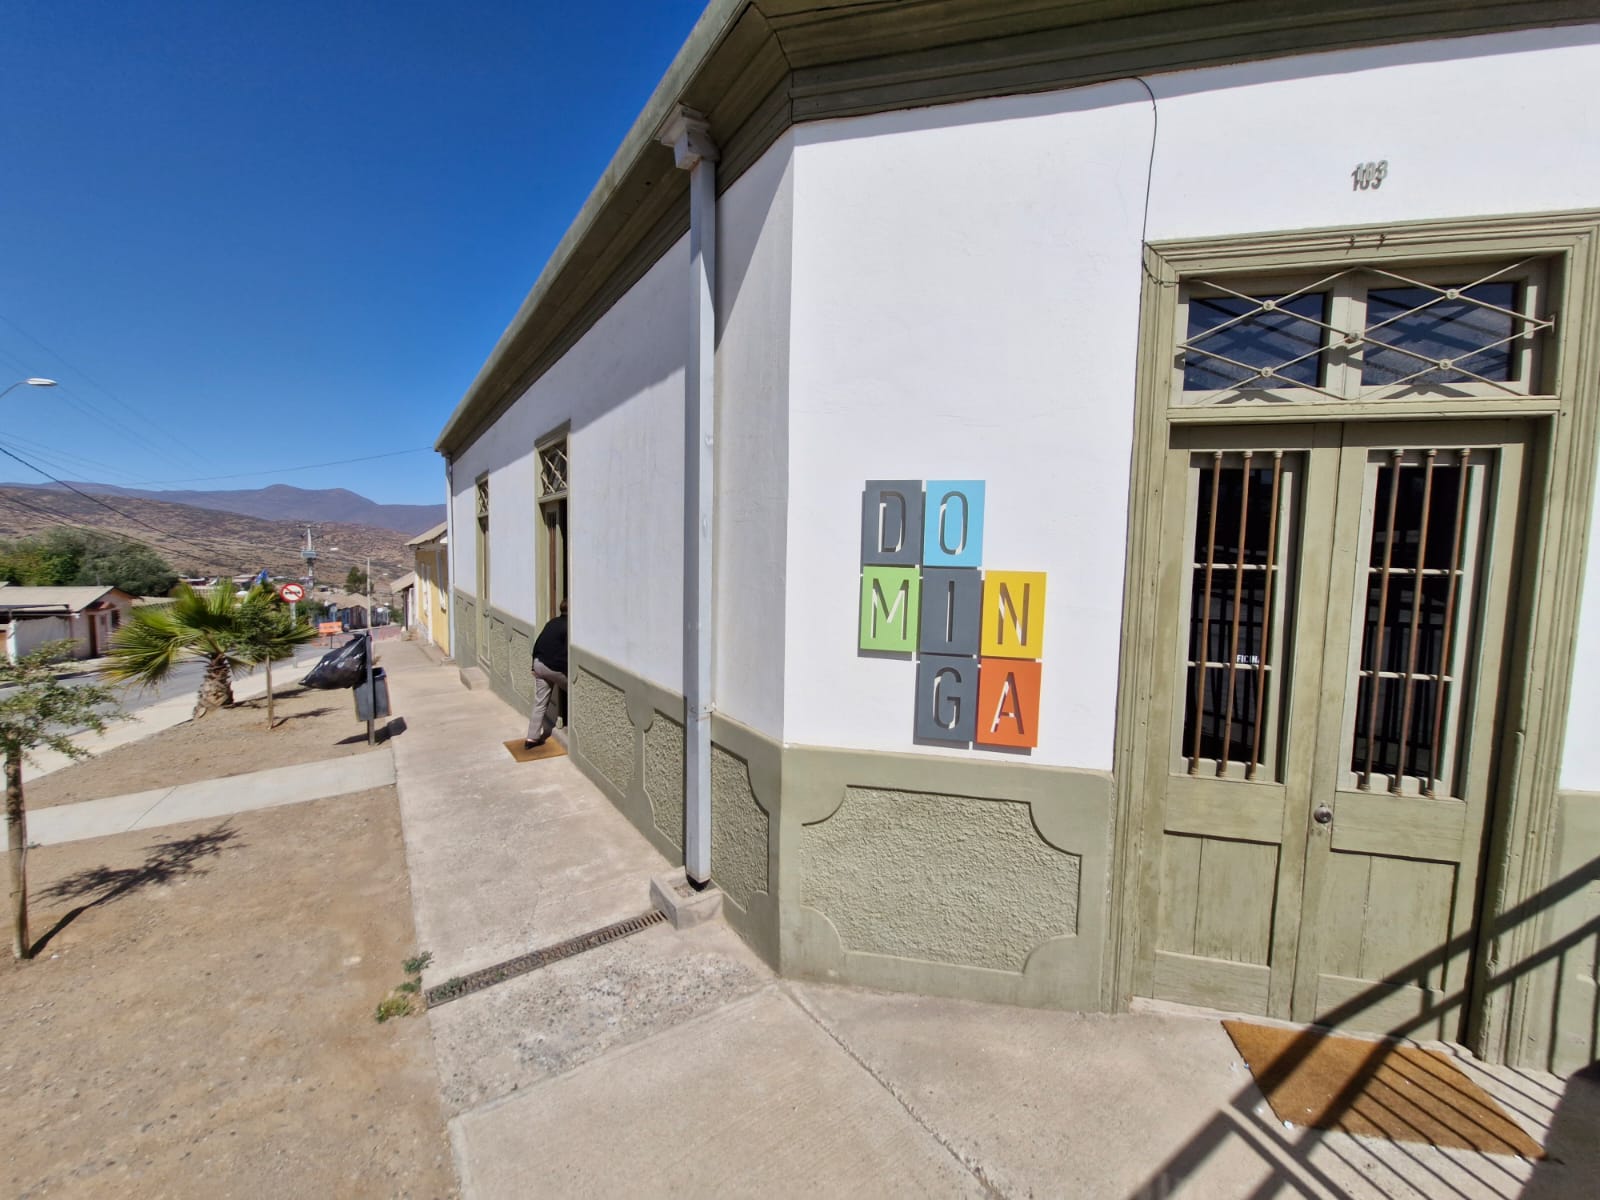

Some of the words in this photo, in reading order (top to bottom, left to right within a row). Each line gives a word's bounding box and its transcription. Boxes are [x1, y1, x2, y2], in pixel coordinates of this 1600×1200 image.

[878, 490, 969, 556] DO
[870, 577, 1031, 647] MIN
[1236, 654, 1260, 664] FICIN
[932, 666, 1025, 735] GA
